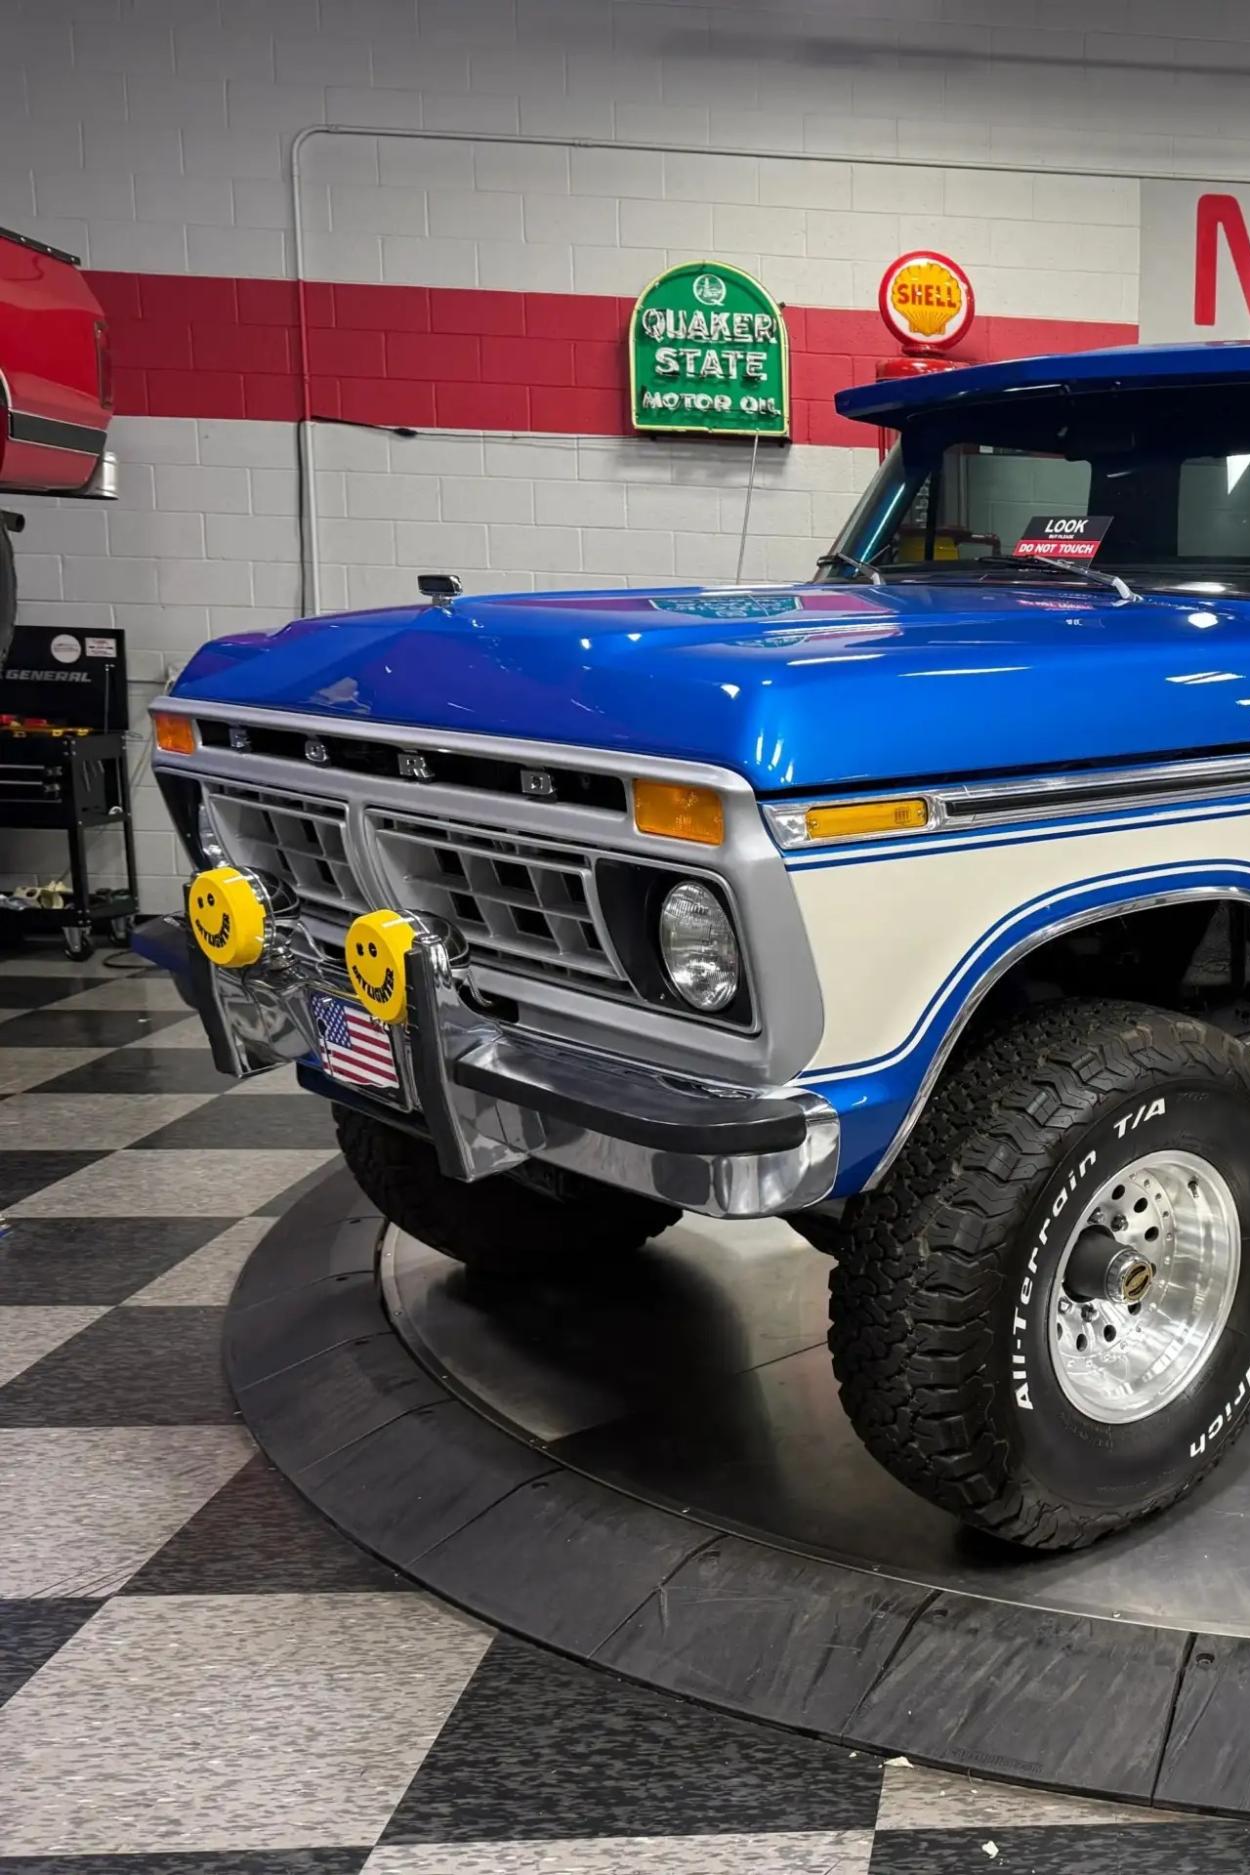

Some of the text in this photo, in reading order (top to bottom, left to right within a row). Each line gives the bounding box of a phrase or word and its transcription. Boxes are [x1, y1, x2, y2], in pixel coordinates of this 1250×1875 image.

[897, 282, 957, 308] SHELL
[642, 308, 777, 344] QUAKER
[655, 347, 768, 381] STATE
[642, 391, 781, 416] MOTOR OIL
[1044, 519, 1089, 534] LOOK
[1018, 543, 1094, 554] DO NOT TOUCH
[5, 669, 92, 683] GENERAL
[1012, 1149, 1097, 1411] All-Terrain
[1113, 1097, 1167, 1139] T/A
